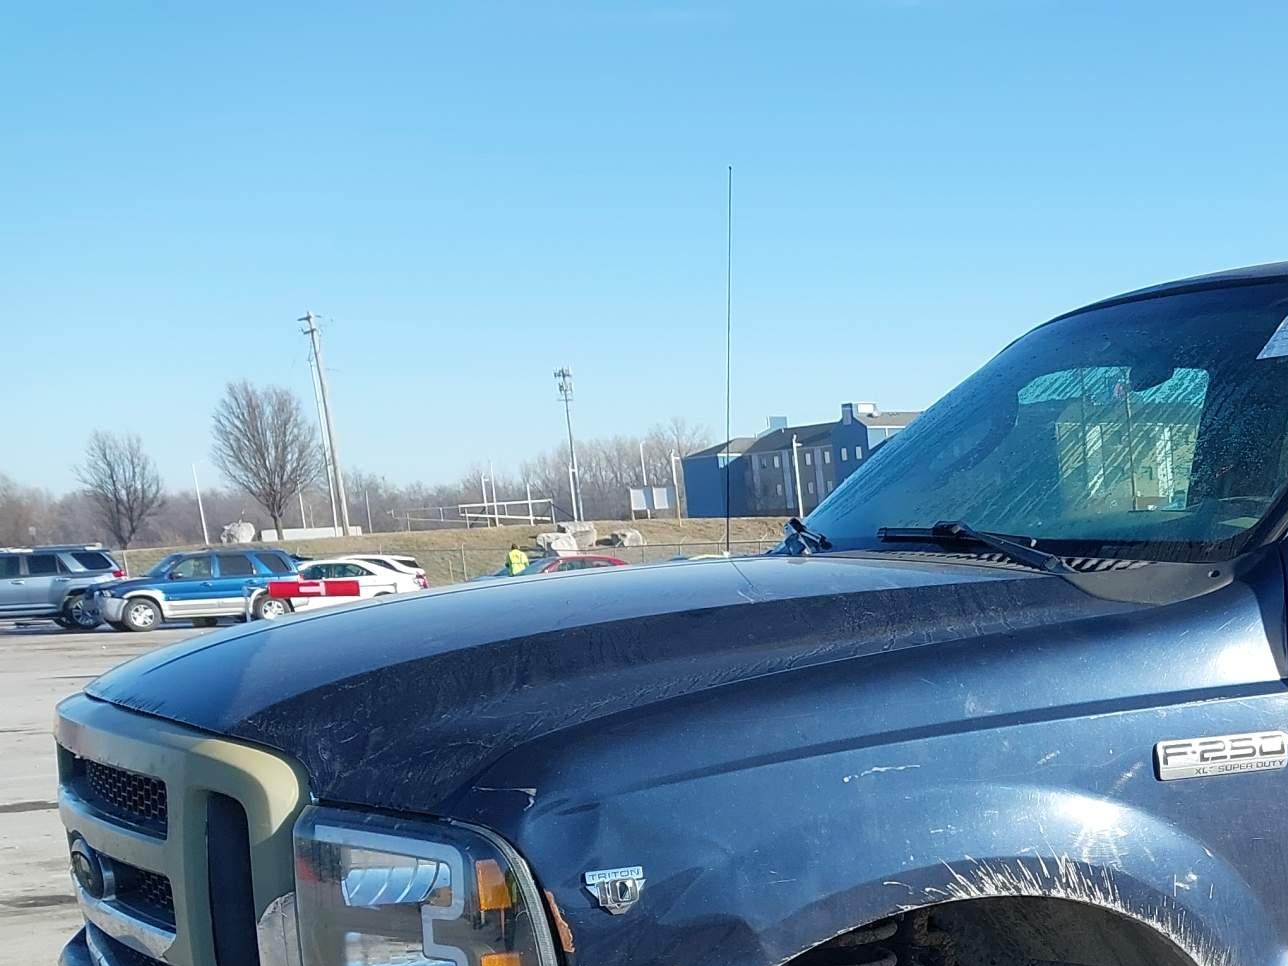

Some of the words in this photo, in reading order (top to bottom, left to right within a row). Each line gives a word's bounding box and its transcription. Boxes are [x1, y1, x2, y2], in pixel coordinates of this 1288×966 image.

[1161, 733, 1286, 766] F-250
[1217, 761, 1254, 773] SUPER
[1255, 758, 1286, 769] DUTY
[588, 868, 640, 881] TRITON
